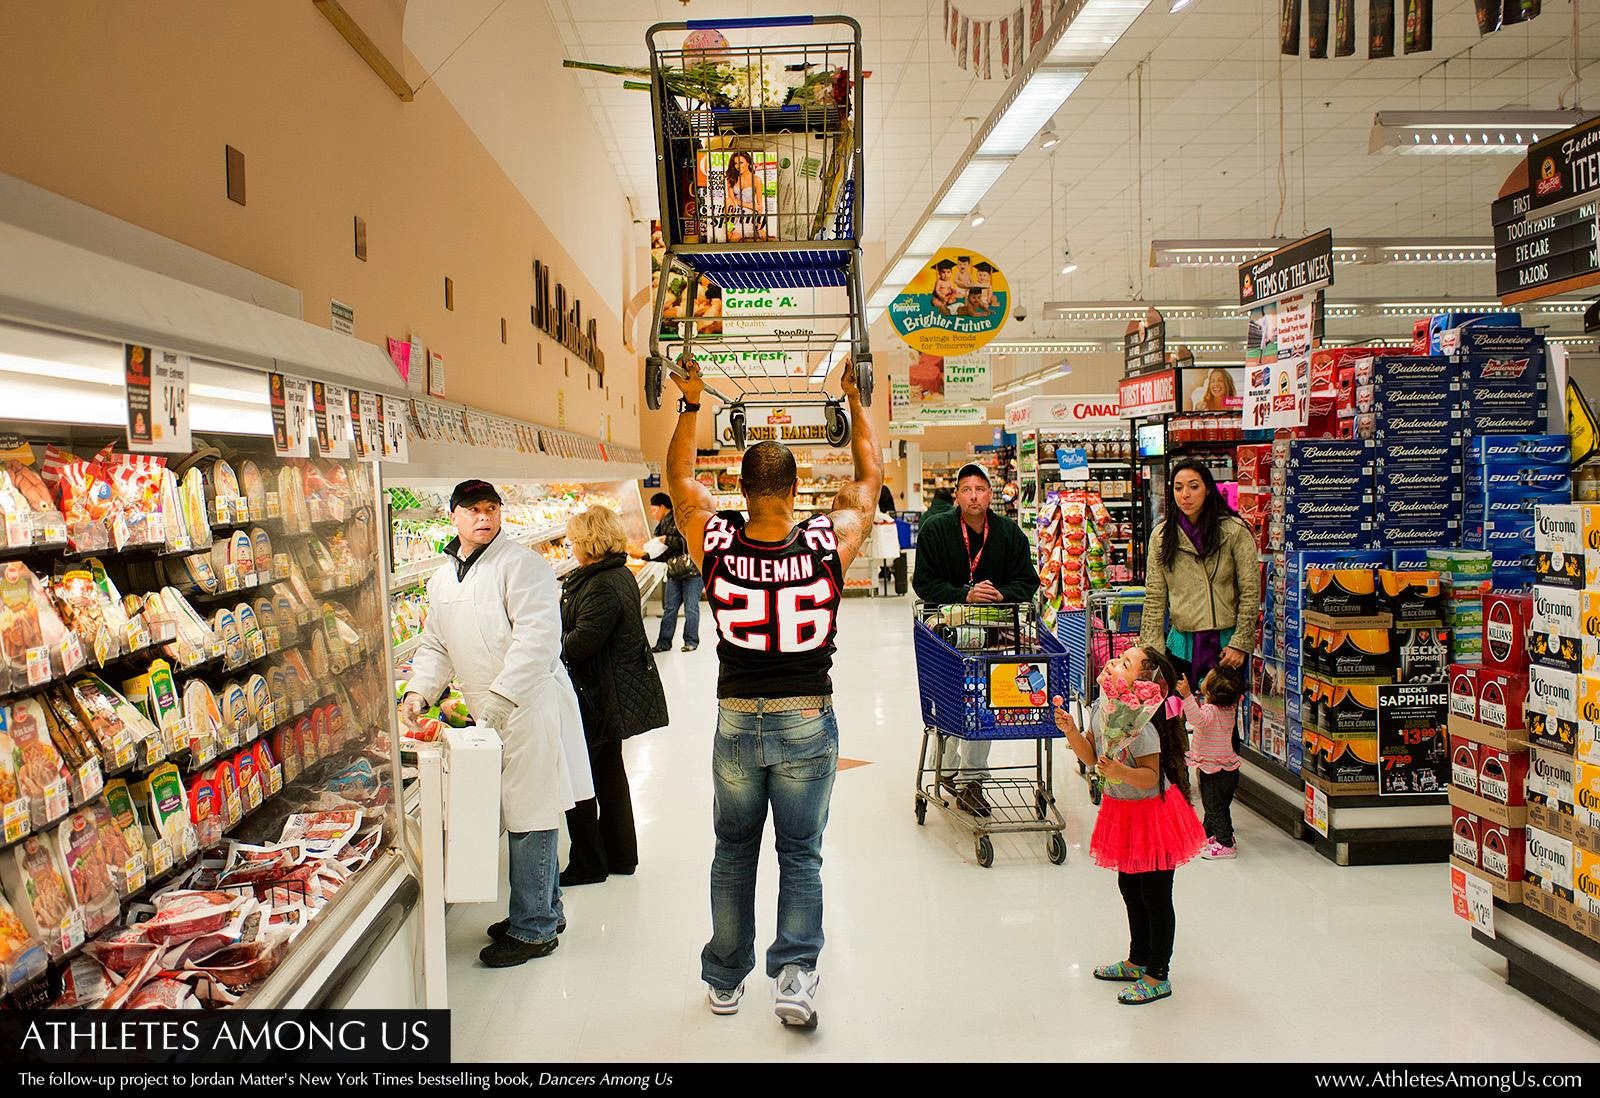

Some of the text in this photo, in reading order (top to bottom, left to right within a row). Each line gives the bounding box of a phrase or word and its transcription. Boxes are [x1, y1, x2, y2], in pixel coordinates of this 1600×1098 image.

[1513, 194, 1531, 215] FIRST
[1507, 216, 1556, 241] TOOTHPASTE
[1516, 237, 1549, 262] EYE CARE
[1256, 253, 1331, 299] ITEMS OF THE WEEK
[1519, 263, 1549, 285] RAZORS
[725, 298, 773, 308] Grade
[893, 304, 921, 314] Pampers
[725, 320, 735, 328] of
[902, 311, 992, 332] Brighter Future
[1472, 334, 1532, 345] Budweiser
[921, 342, 932, 350] for
[742, 351, 792, 361] Fresh.
[1386, 363, 1447, 374] Budweiser
[1153, 377, 1173, 402] MORE
[1472, 388, 1535, 400] Budweiser
[1386, 390, 1448, 402] Budweiser
[1073, 403, 1120, 419] CANAD
[1387, 418, 1449, 429] Budweiser
[1474, 416, 1535, 428] Budweiser
[724, 426, 777, 441] CNER
[1302, 446, 1361, 458] Budweiser
[1387, 445, 1448, 457] Budweiser
[1487, 446, 1565, 454] BUD LIGHT
[1298, 474, 1359, 486] Budweiser
[1387, 473, 1449, 485] Budweiser
[1527, 474, 1565, 482] LIGHT
[1297, 502, 1359, 514] Budweiser
[1387, 500, 1449, 512] Budweiser
[1490, 502, 1522, 510] BUD
[1539, 516, 1576, 537] Corona
[1296, 529, 1358, 541] Budweiser
[1383, 528, 1445, 540] Budweiser
[1488, 531, 1519, 539] BUD
[723, 554, 813, 582] COLEMAN
[1492, 559, 1522, 567] BUD
[1537, 598, 1572, 618] Corona
[714, 577, 834, 653] 26
[1400, 646, 1447, 654] BECK'S
[1534, 678, 1570, 699] Corona
[1380, 694, 1447, 706] SAPPHIRE
[1534, 757, 1571, 784] Corona
[1529, 837, 1566, 866] Corona
